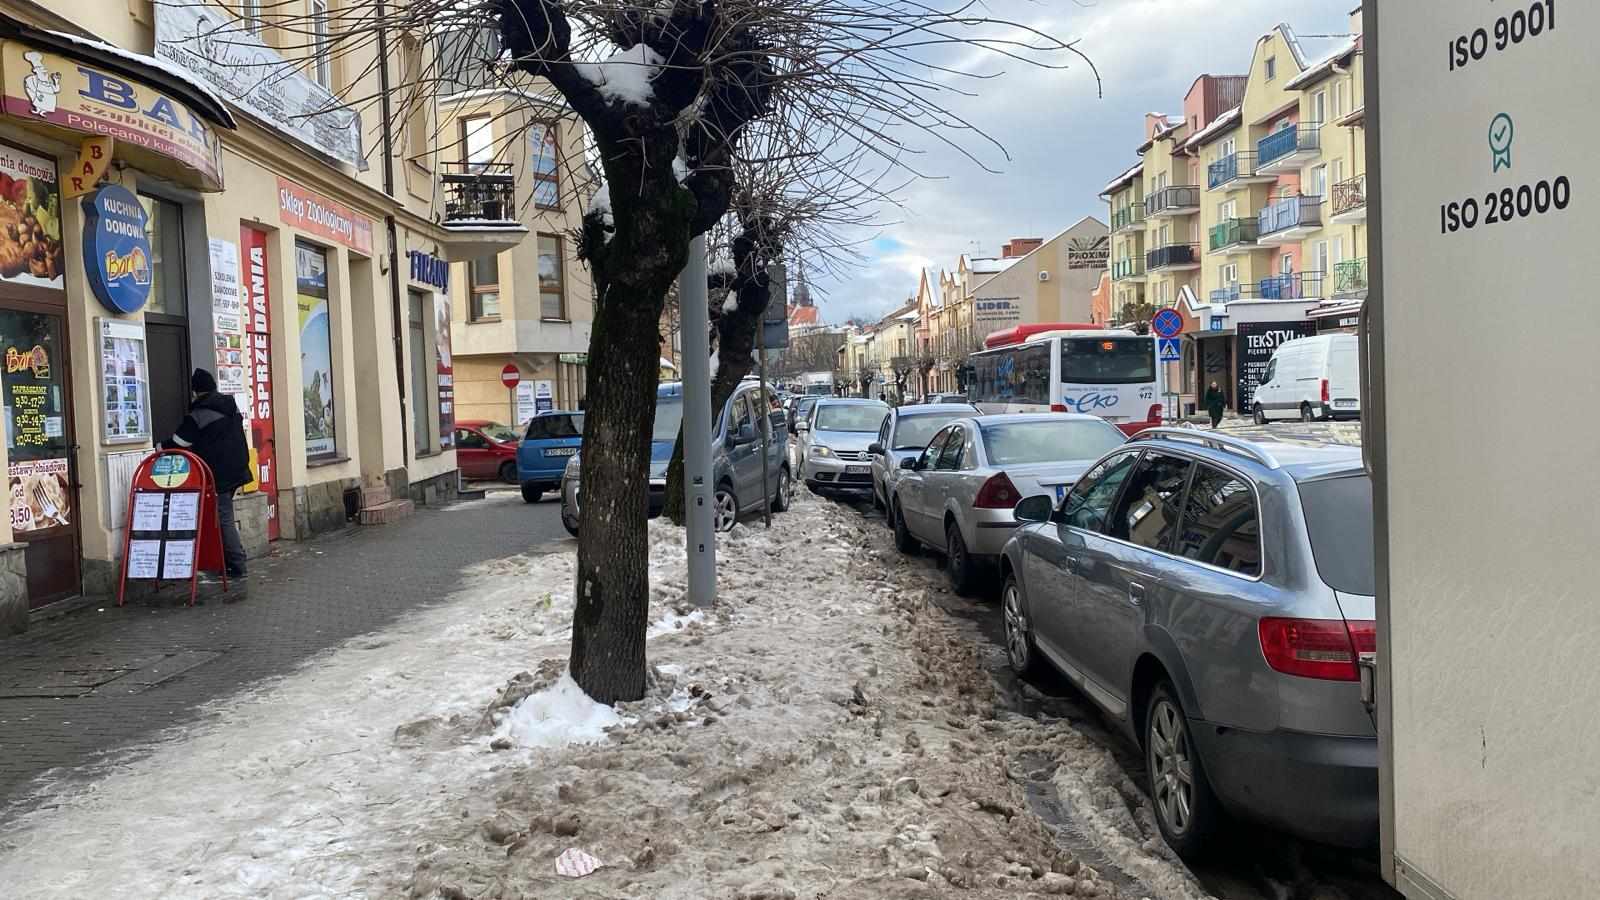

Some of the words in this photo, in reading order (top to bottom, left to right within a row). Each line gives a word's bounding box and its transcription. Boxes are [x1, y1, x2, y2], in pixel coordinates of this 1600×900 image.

[1448, 28, 1488, 72] ISO
[1494, 0, 1555, 51] 9001
[77, 66, 210, 149] BAR
[67, 113, 151, 146] Polecamy
[17, 159, 55, 181] domowa
[71, 145, 104, 192] BAR
[103, 198, 143, 220] KUCHNIA
[280, 188, 304, 223] Sklep
[1440, 198, 1479, 234] ISO
[1485, 175, 1571, 225] 28000
[105, 218, 144, 239] DOMOWA
[106, 250, 132, 281] Bar
[250, 247, 271, 420] SPRZEDANIA
[1247, 329, 1305, 348] TEKSTYL
[8, 465, 33, 477] estawy
[15, 485, 24, 498] od
